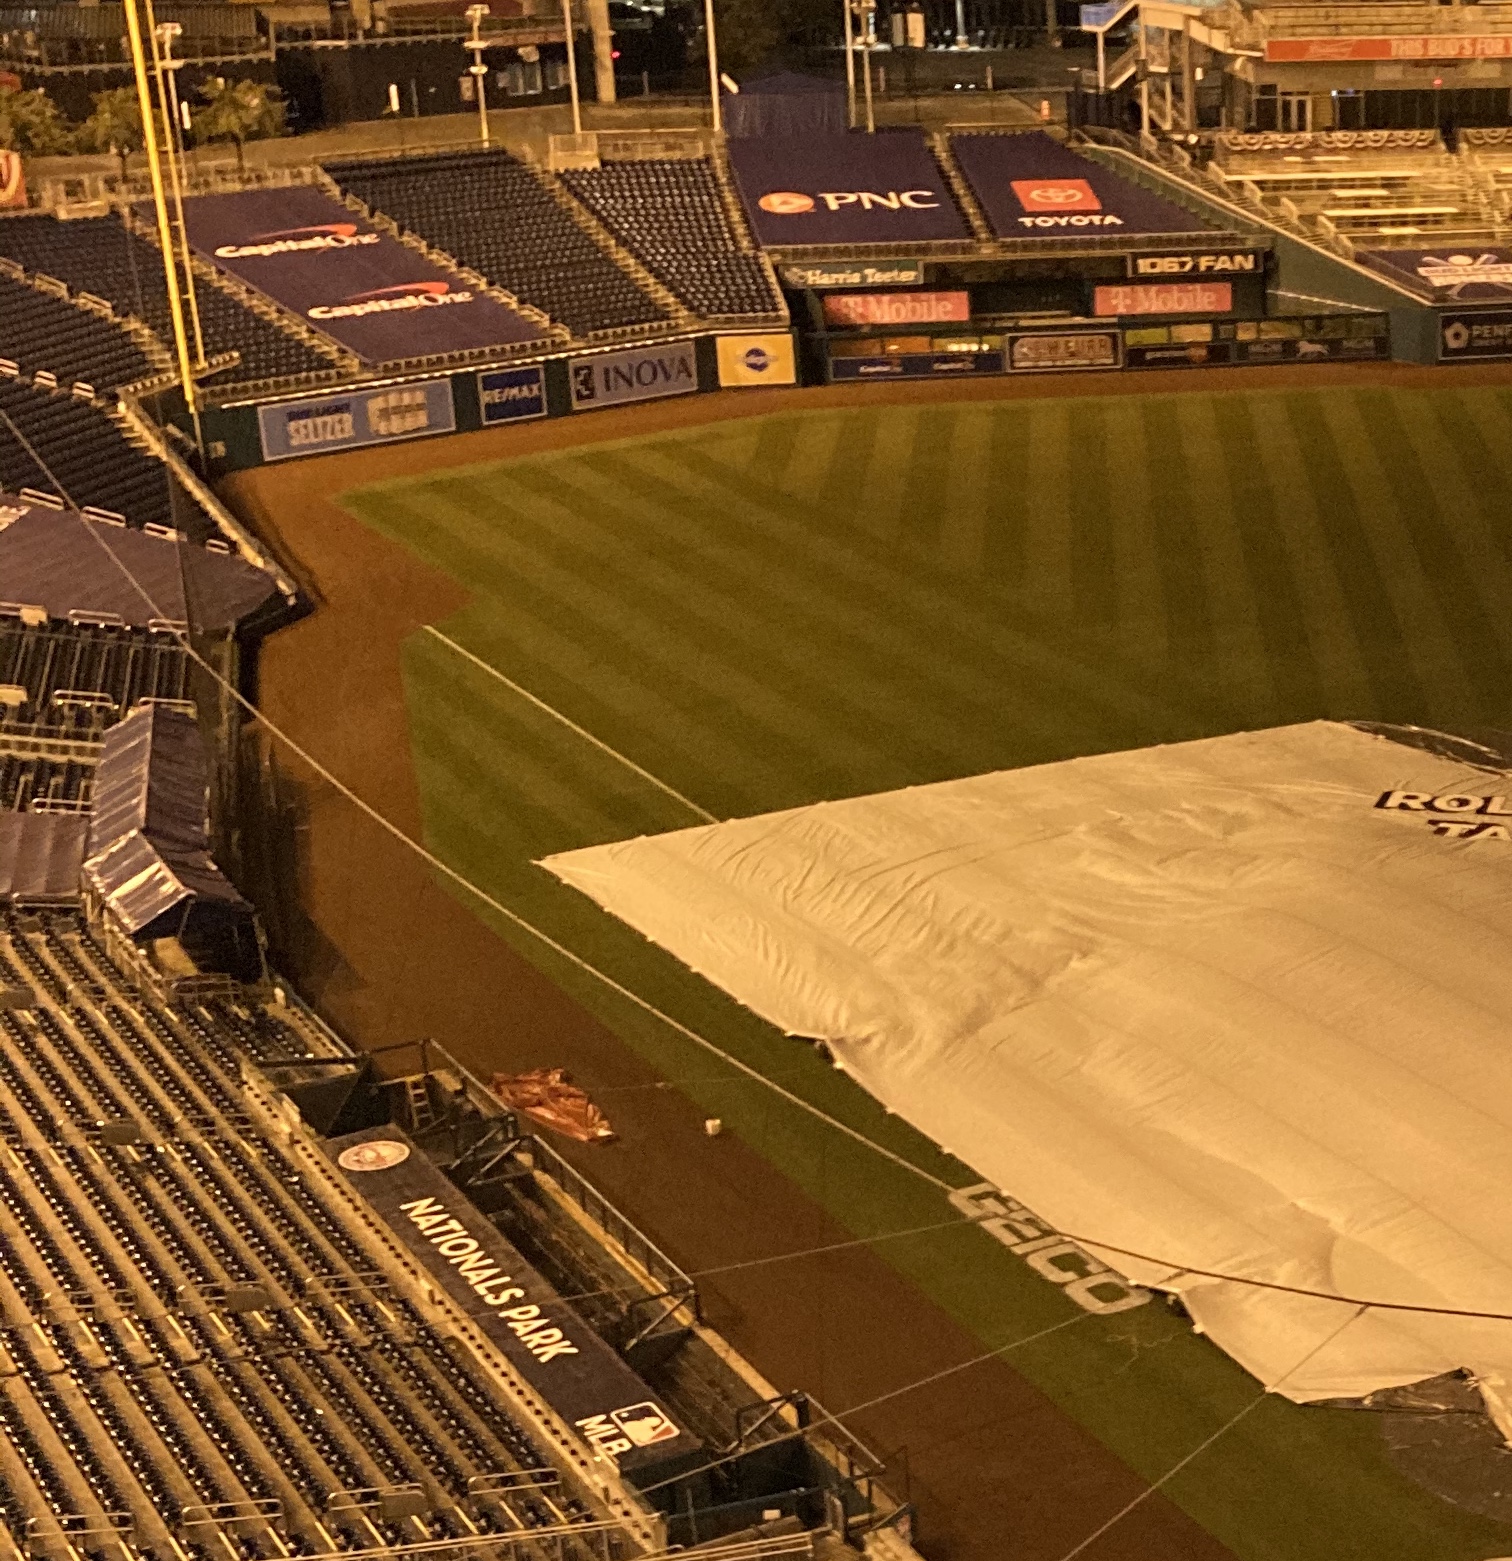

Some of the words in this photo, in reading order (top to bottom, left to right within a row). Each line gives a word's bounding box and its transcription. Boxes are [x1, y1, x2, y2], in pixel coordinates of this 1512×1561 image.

[1476, 38, 1507, 54] FOR
[817, 190, 940, 211] PNC
[1017, 215, 1124, 228] TOYOTA
[1199, 254, 1255, 271] FAN
[805, 269, 861, 285] Harris
[863, 268, 919, 283] Teeter
[603, 358, 693, 392] INOVA
[400, 1197, 525, 1306] NATIONALS
[499, 1304, 579, 1363] PARK
